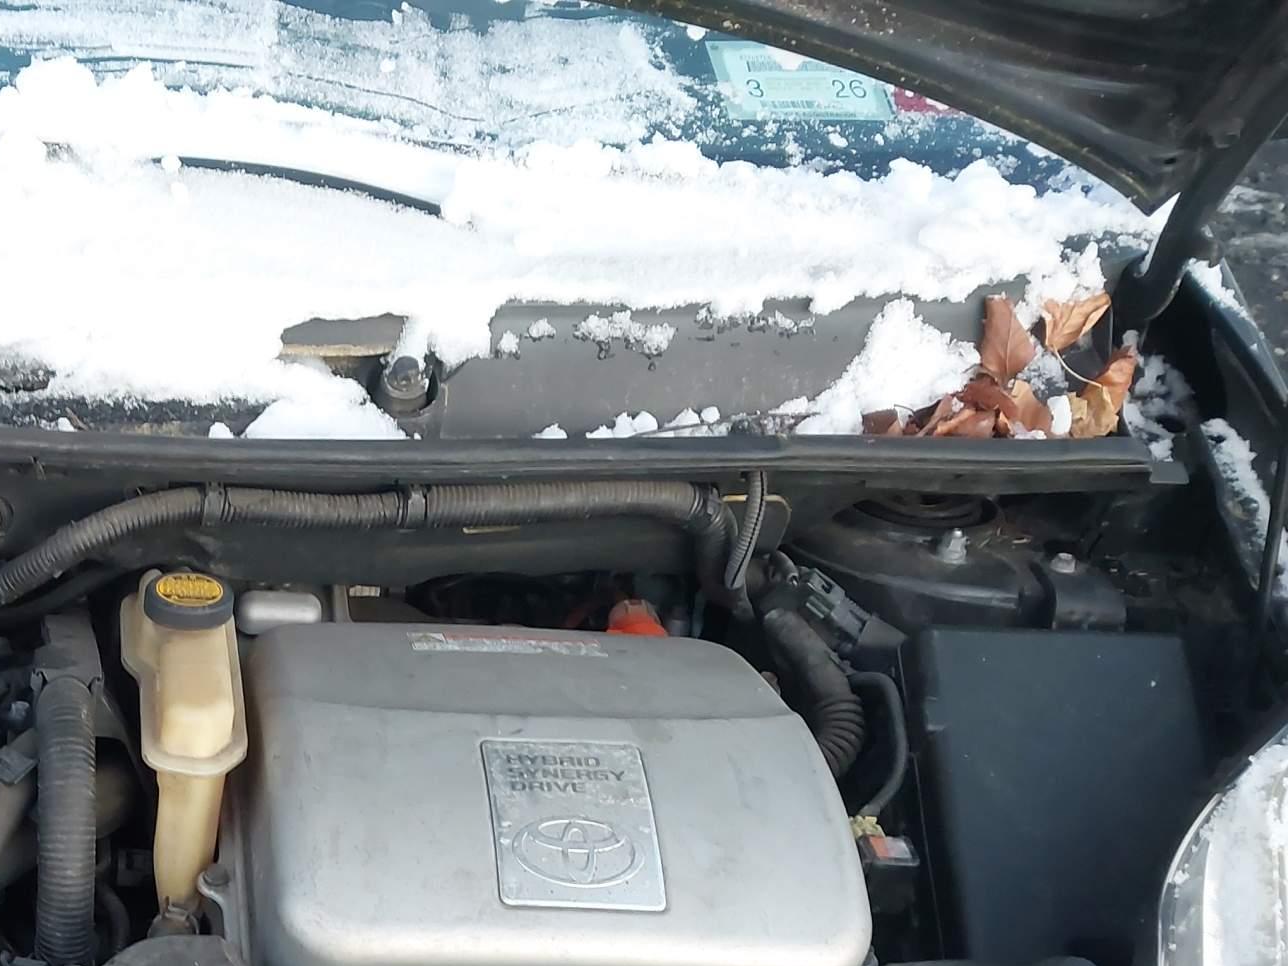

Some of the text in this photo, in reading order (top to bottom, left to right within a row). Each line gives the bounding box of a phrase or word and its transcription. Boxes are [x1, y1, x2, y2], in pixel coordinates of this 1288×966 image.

[746, 80, 763, 97] 3
[832, 80, 866, 98] 26
[507, 754, 600, 767] HYBRID
[508, 767, 624, 781] SYNERGY
[511, 781, 586, 793] DRIVE
